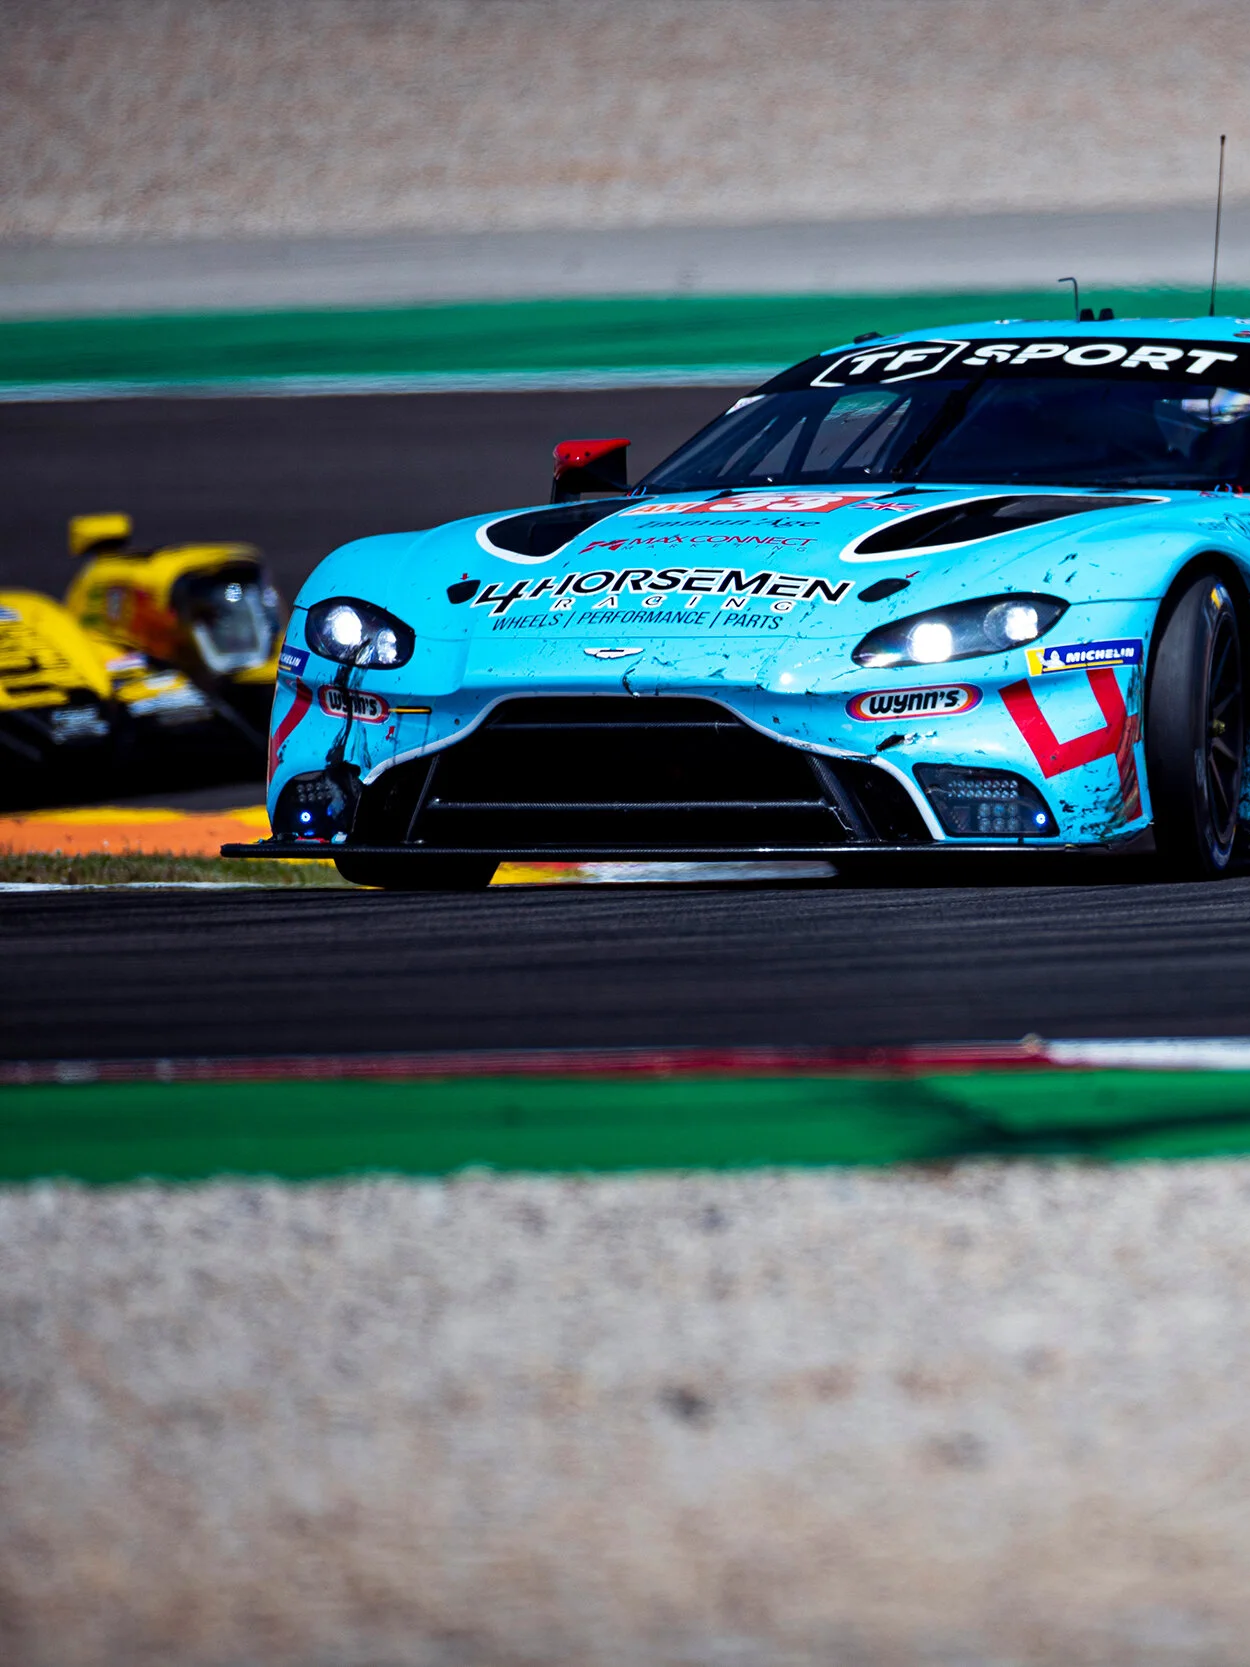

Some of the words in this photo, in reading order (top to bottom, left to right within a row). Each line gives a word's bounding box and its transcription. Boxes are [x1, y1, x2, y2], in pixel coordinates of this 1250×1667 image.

[848, 347, 946, 376] TF
[961, 343, 1239, 375] SPORT
[708, 496, 844, 511] 33
[691, 535, 819, 547] CONNECT
[471, 567, 854, 618] 4HORSEMEN
[549, 595, 796, 612] RACING
[492, 613, 563, 631] WHEELS
[577, 610, 709, 629] PERFORMANCE
[724, 613, 784, 630] PARTS
[1065, 647, 1135, 663] MICHELIN
